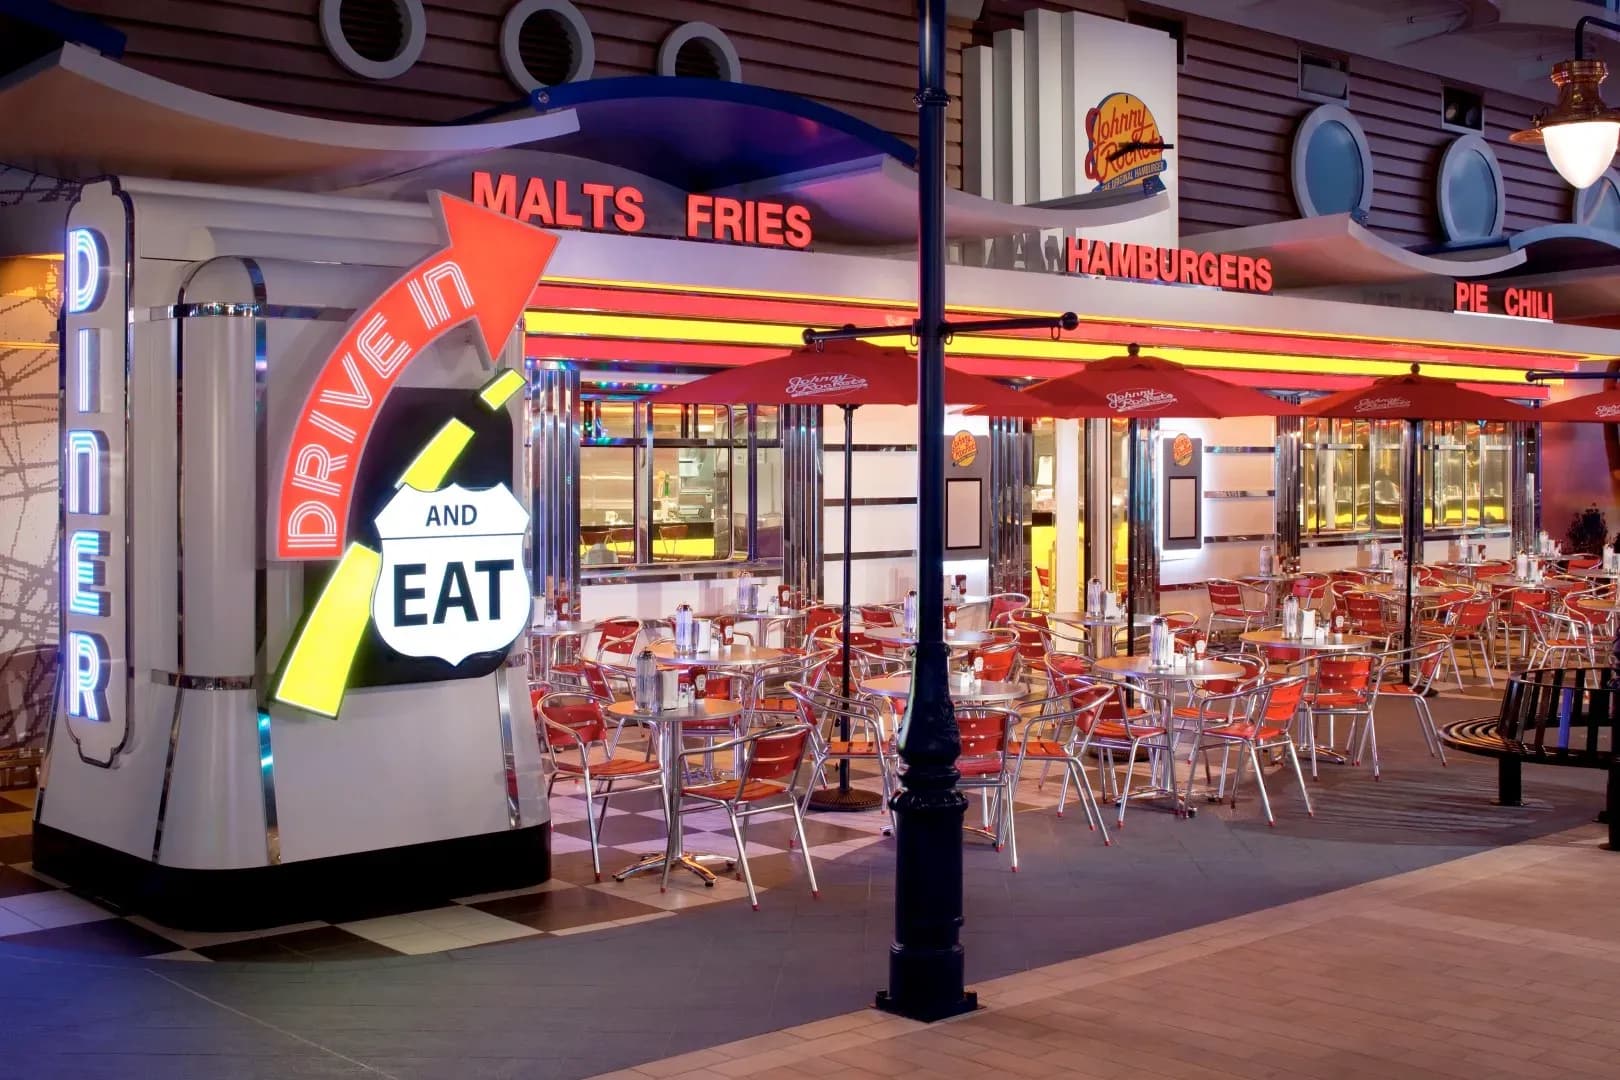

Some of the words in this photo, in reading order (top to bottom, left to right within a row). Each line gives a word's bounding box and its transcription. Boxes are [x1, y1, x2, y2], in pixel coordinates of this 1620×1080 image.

[473, 171, 645, 233] MALTS
[686, 193, 813, 248] FRIES
[1066, 236, 1274, 292] HAMBURGERS
[1454, 281, 1489, 313] PIE
[1504, 287, 1554, 320] CHILI
[786, 374, 848, 393] Johnny
[287, 312, 412, 548] DRIVE
[426, 504, 478, 527] AND
[394, 559, 515, 628] EAT
